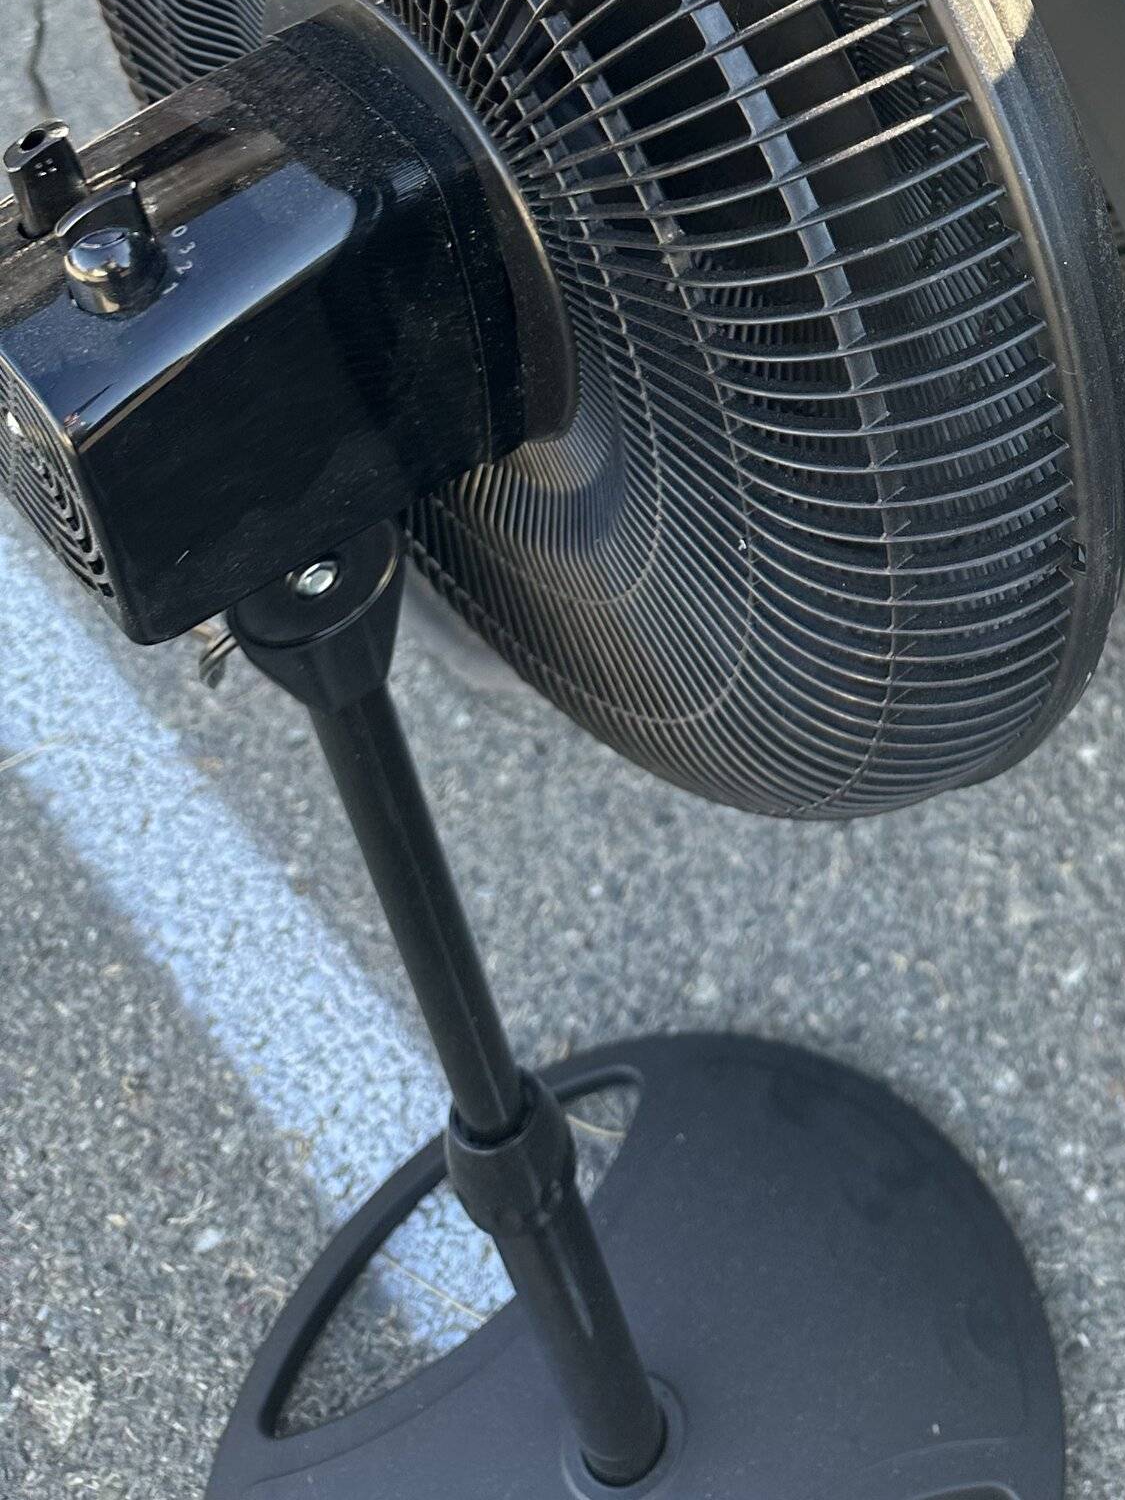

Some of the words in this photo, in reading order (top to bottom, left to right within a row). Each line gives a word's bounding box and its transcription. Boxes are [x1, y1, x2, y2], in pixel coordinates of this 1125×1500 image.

[172, 225, 188, 237] 0
[179, 241, 195, 254] 3
[175, 261, 192, 275] 2
[163, 283, 178, 295] 1
